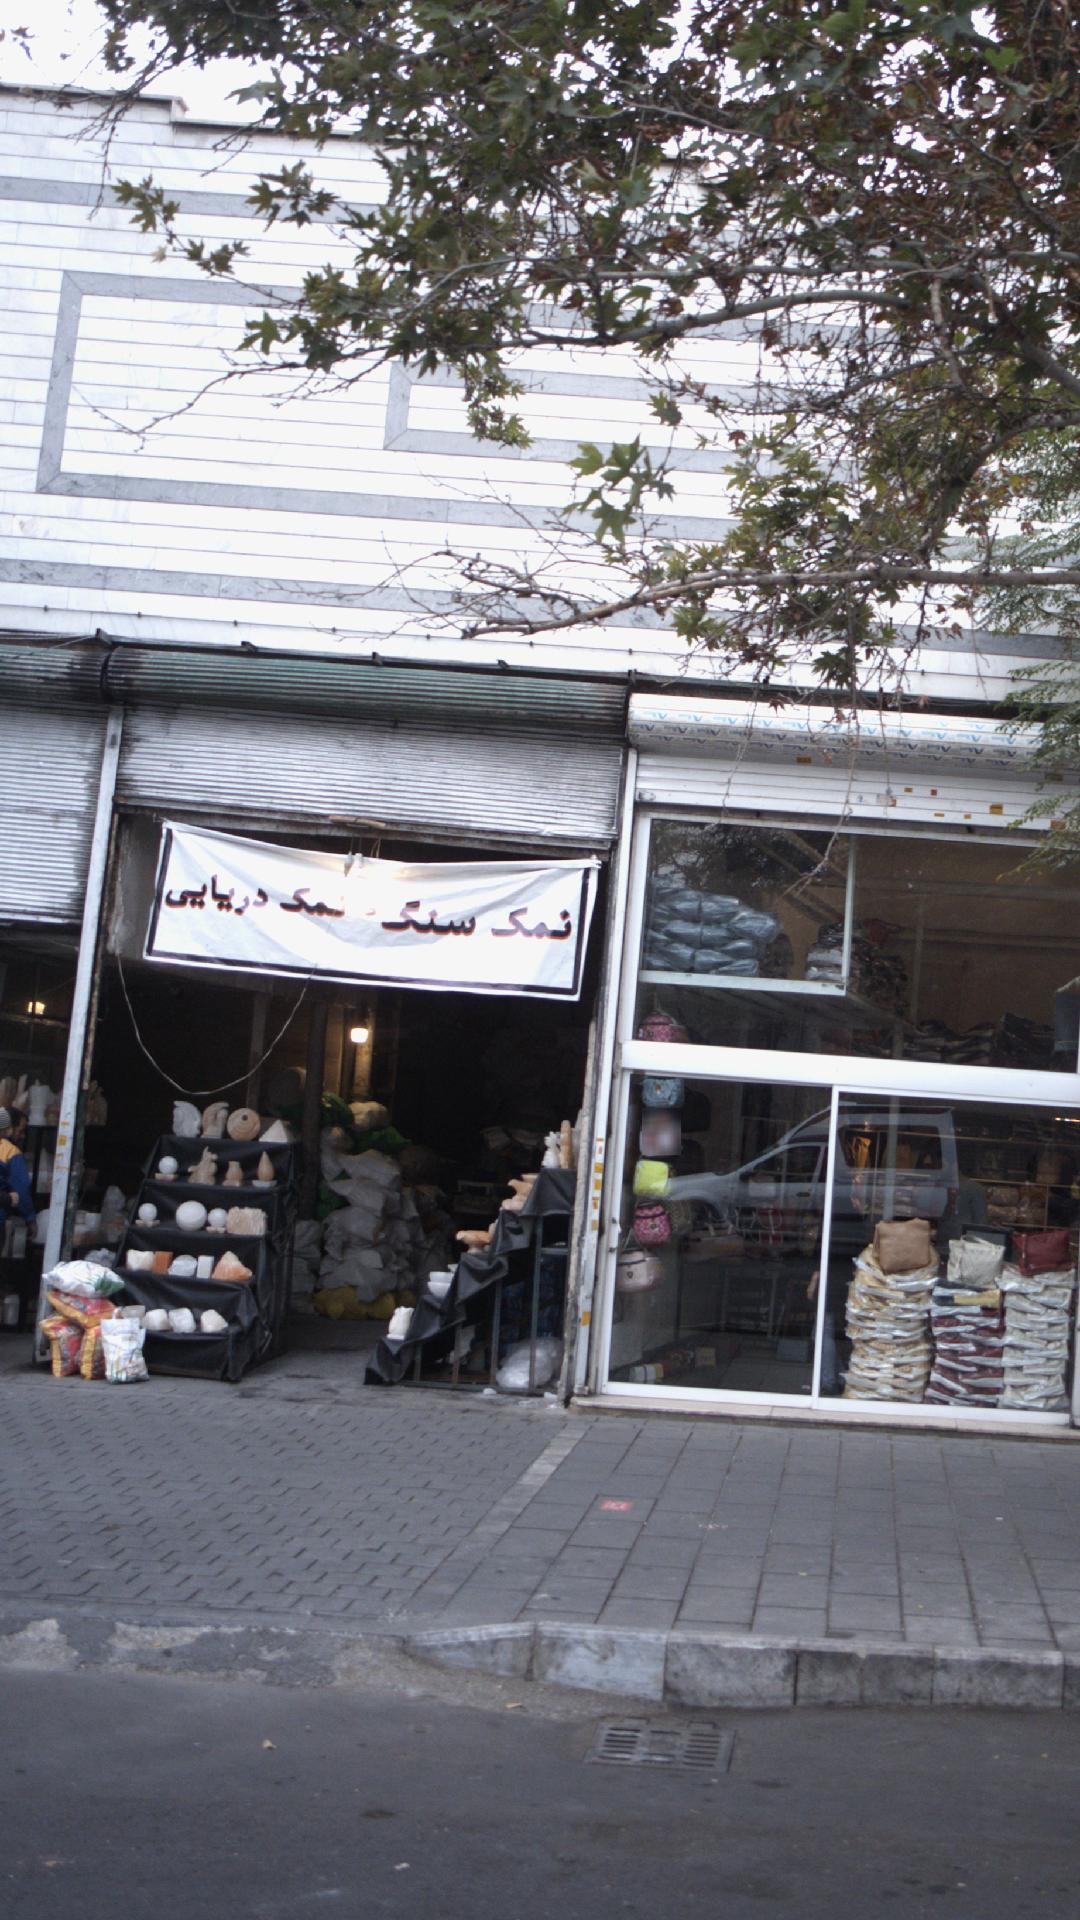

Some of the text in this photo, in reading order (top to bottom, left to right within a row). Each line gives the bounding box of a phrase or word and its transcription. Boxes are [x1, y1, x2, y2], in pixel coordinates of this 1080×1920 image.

[165, 873, 269, 916] دریایی
[381, 900, 476, 937] سنگ
[491, 907, 572, 941] نمک
